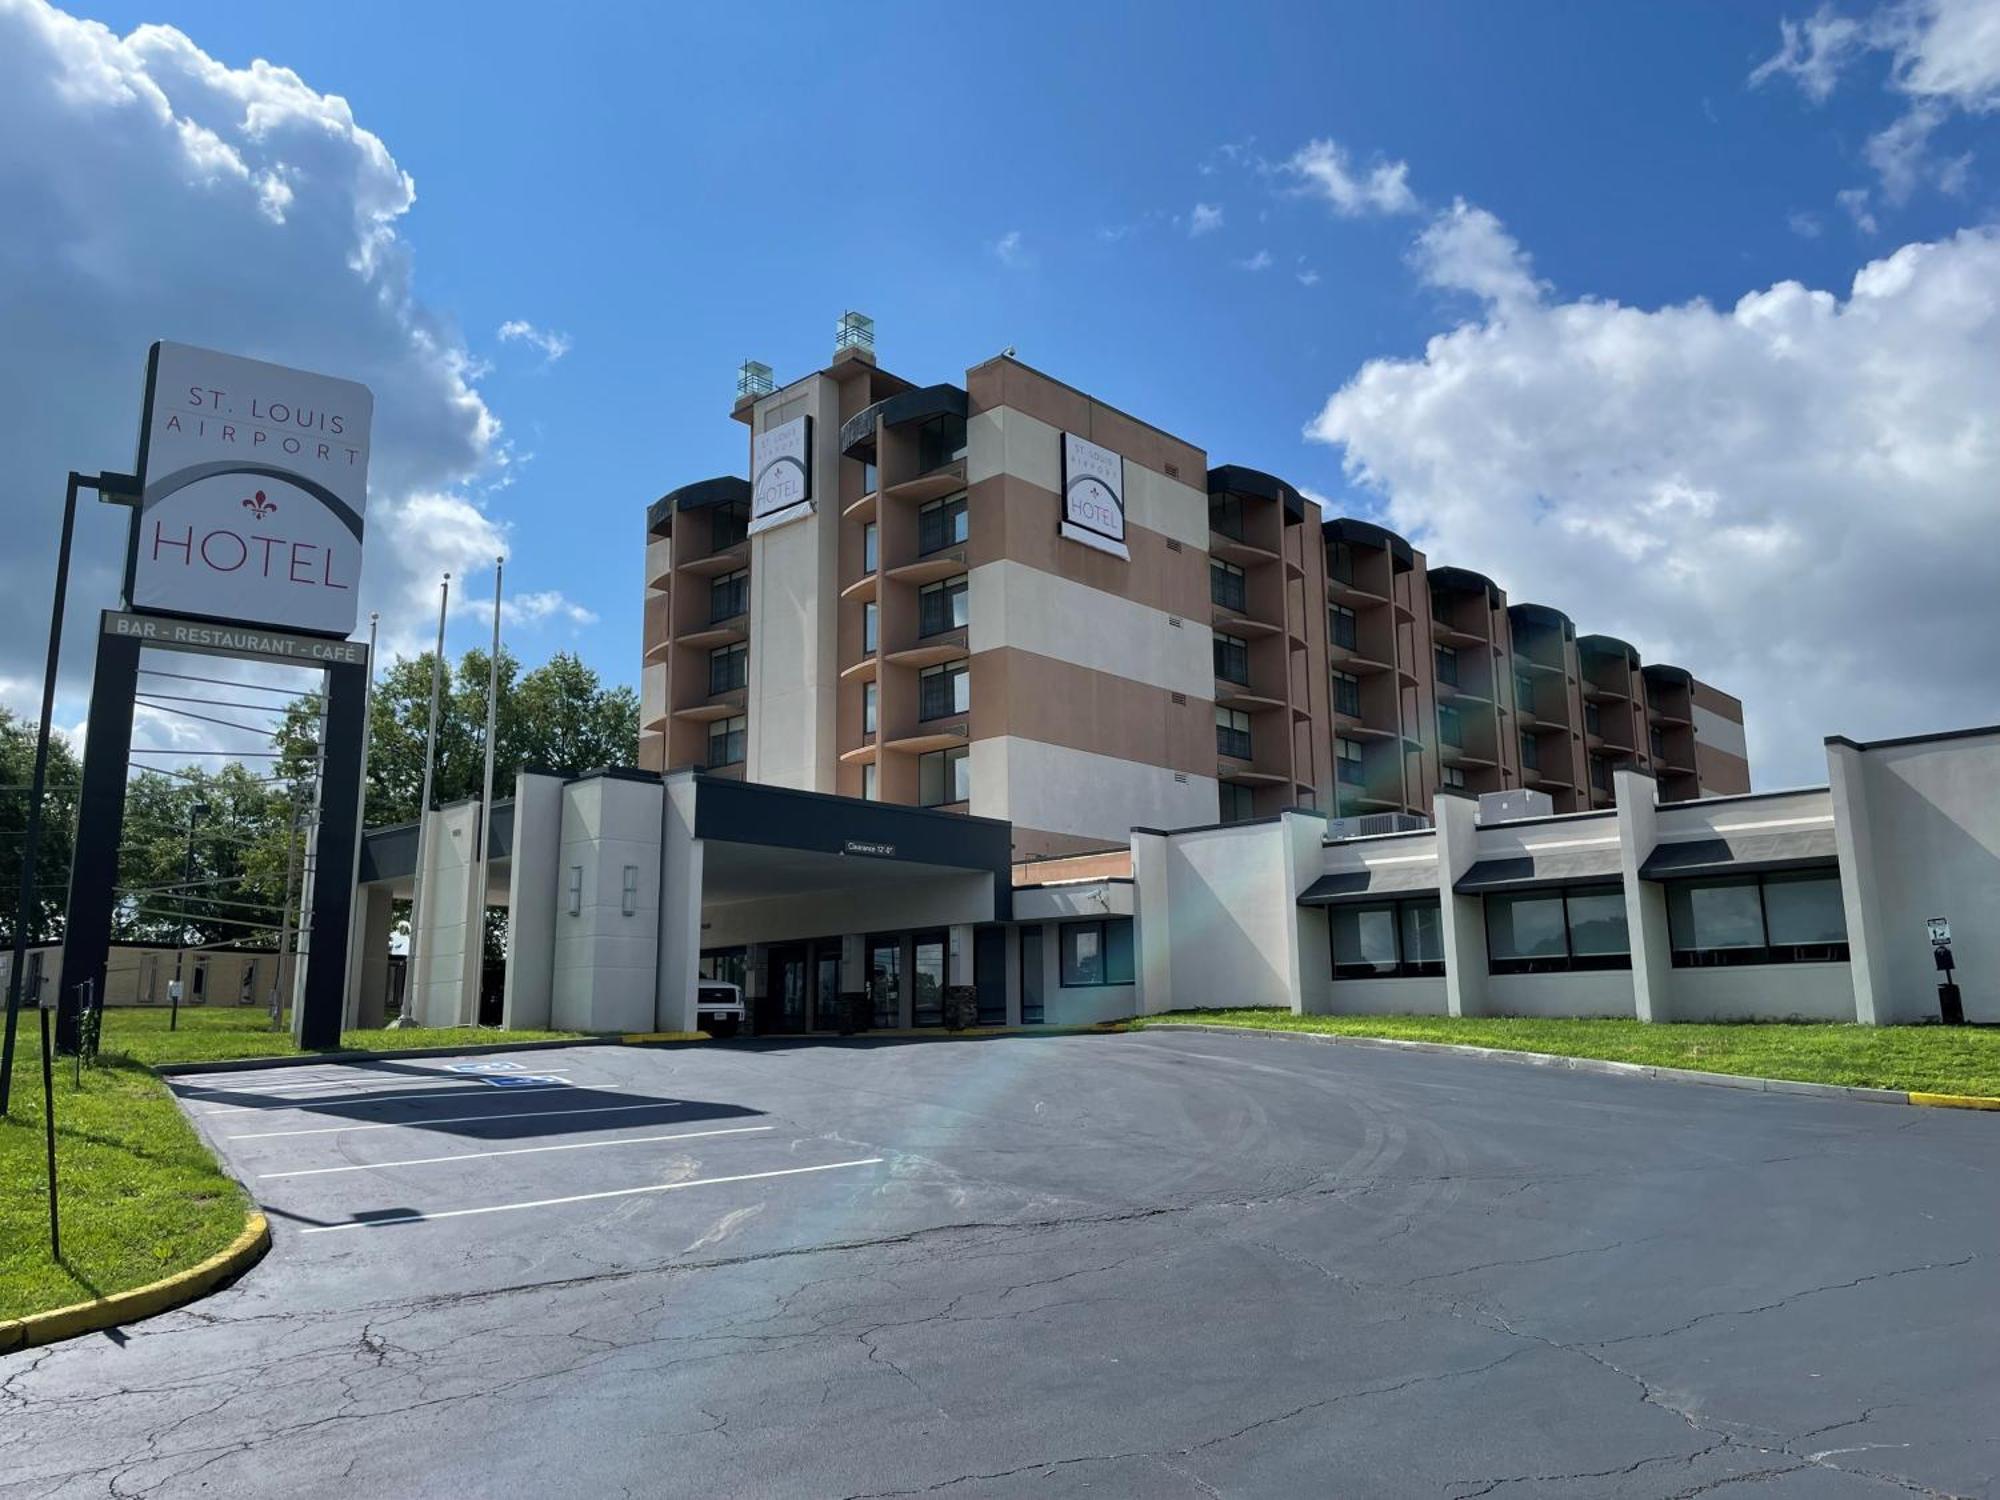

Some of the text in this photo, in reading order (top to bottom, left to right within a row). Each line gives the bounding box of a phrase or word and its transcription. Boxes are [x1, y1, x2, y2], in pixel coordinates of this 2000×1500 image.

[189, 387, 344, 434] ST. LOUIS
[166, 415, 359, 465] AIRPORT
[756, 479, 799, 510] HOTEL
[1071, 497, 1118, 528] HOTEL
[153, 521, 348, 589] HOTEL
[117, 618, 156, 637] BAR
[175, 627, 296, 655] RESTAURANT
